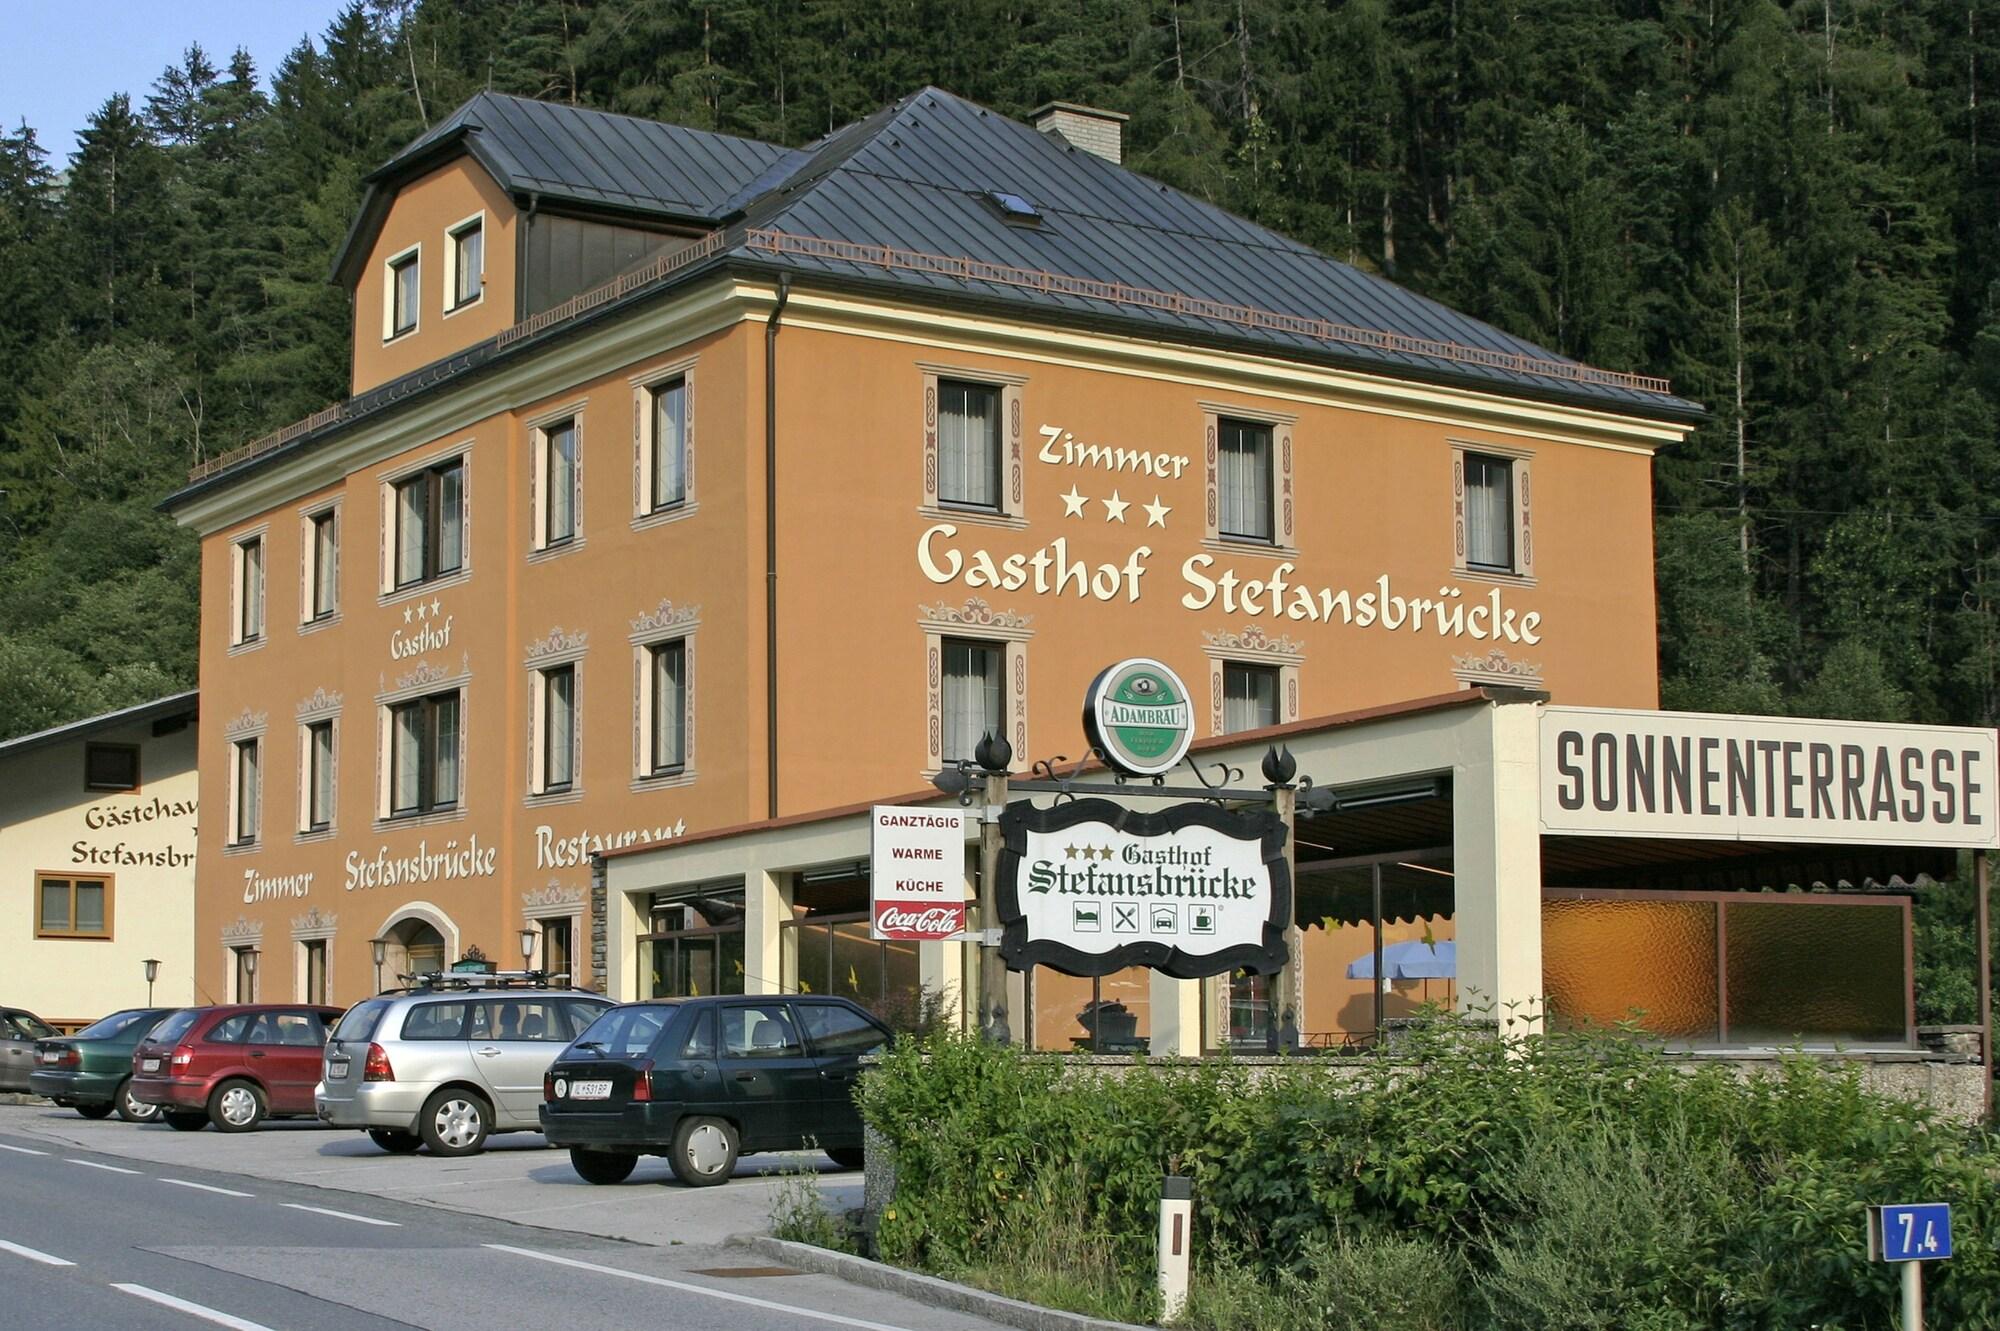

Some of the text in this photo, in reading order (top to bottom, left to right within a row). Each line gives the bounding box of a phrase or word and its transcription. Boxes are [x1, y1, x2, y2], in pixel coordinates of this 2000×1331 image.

[1038, 424, 1190, 479] Zimmer
[917, 523, 1542, 646] Gasthof Stefansbrücke
[391, 615, 453, 661] Gasthof
[1110, 705, 1180, 726] ADAMBRÄU
[1557, 730, 1982, 825] SONNENTERRASSE
[879, 814, 960, 829] GANZTÄGIG
[345, 834, 497, 891] Stefansbrücke
[892, 847, 944, 860] WARME
[1121, 843, 1213, 870] Gasthof
[243, 868, 314, 904] Zimmer
[895, 878, 945, 892] KÜCHE
[1027, 860, 1258, 900] Stefansbrücke
[877, 906, 962, 934] Coca-Cola
[1898, 1212, 1938, 1254] 7,4
